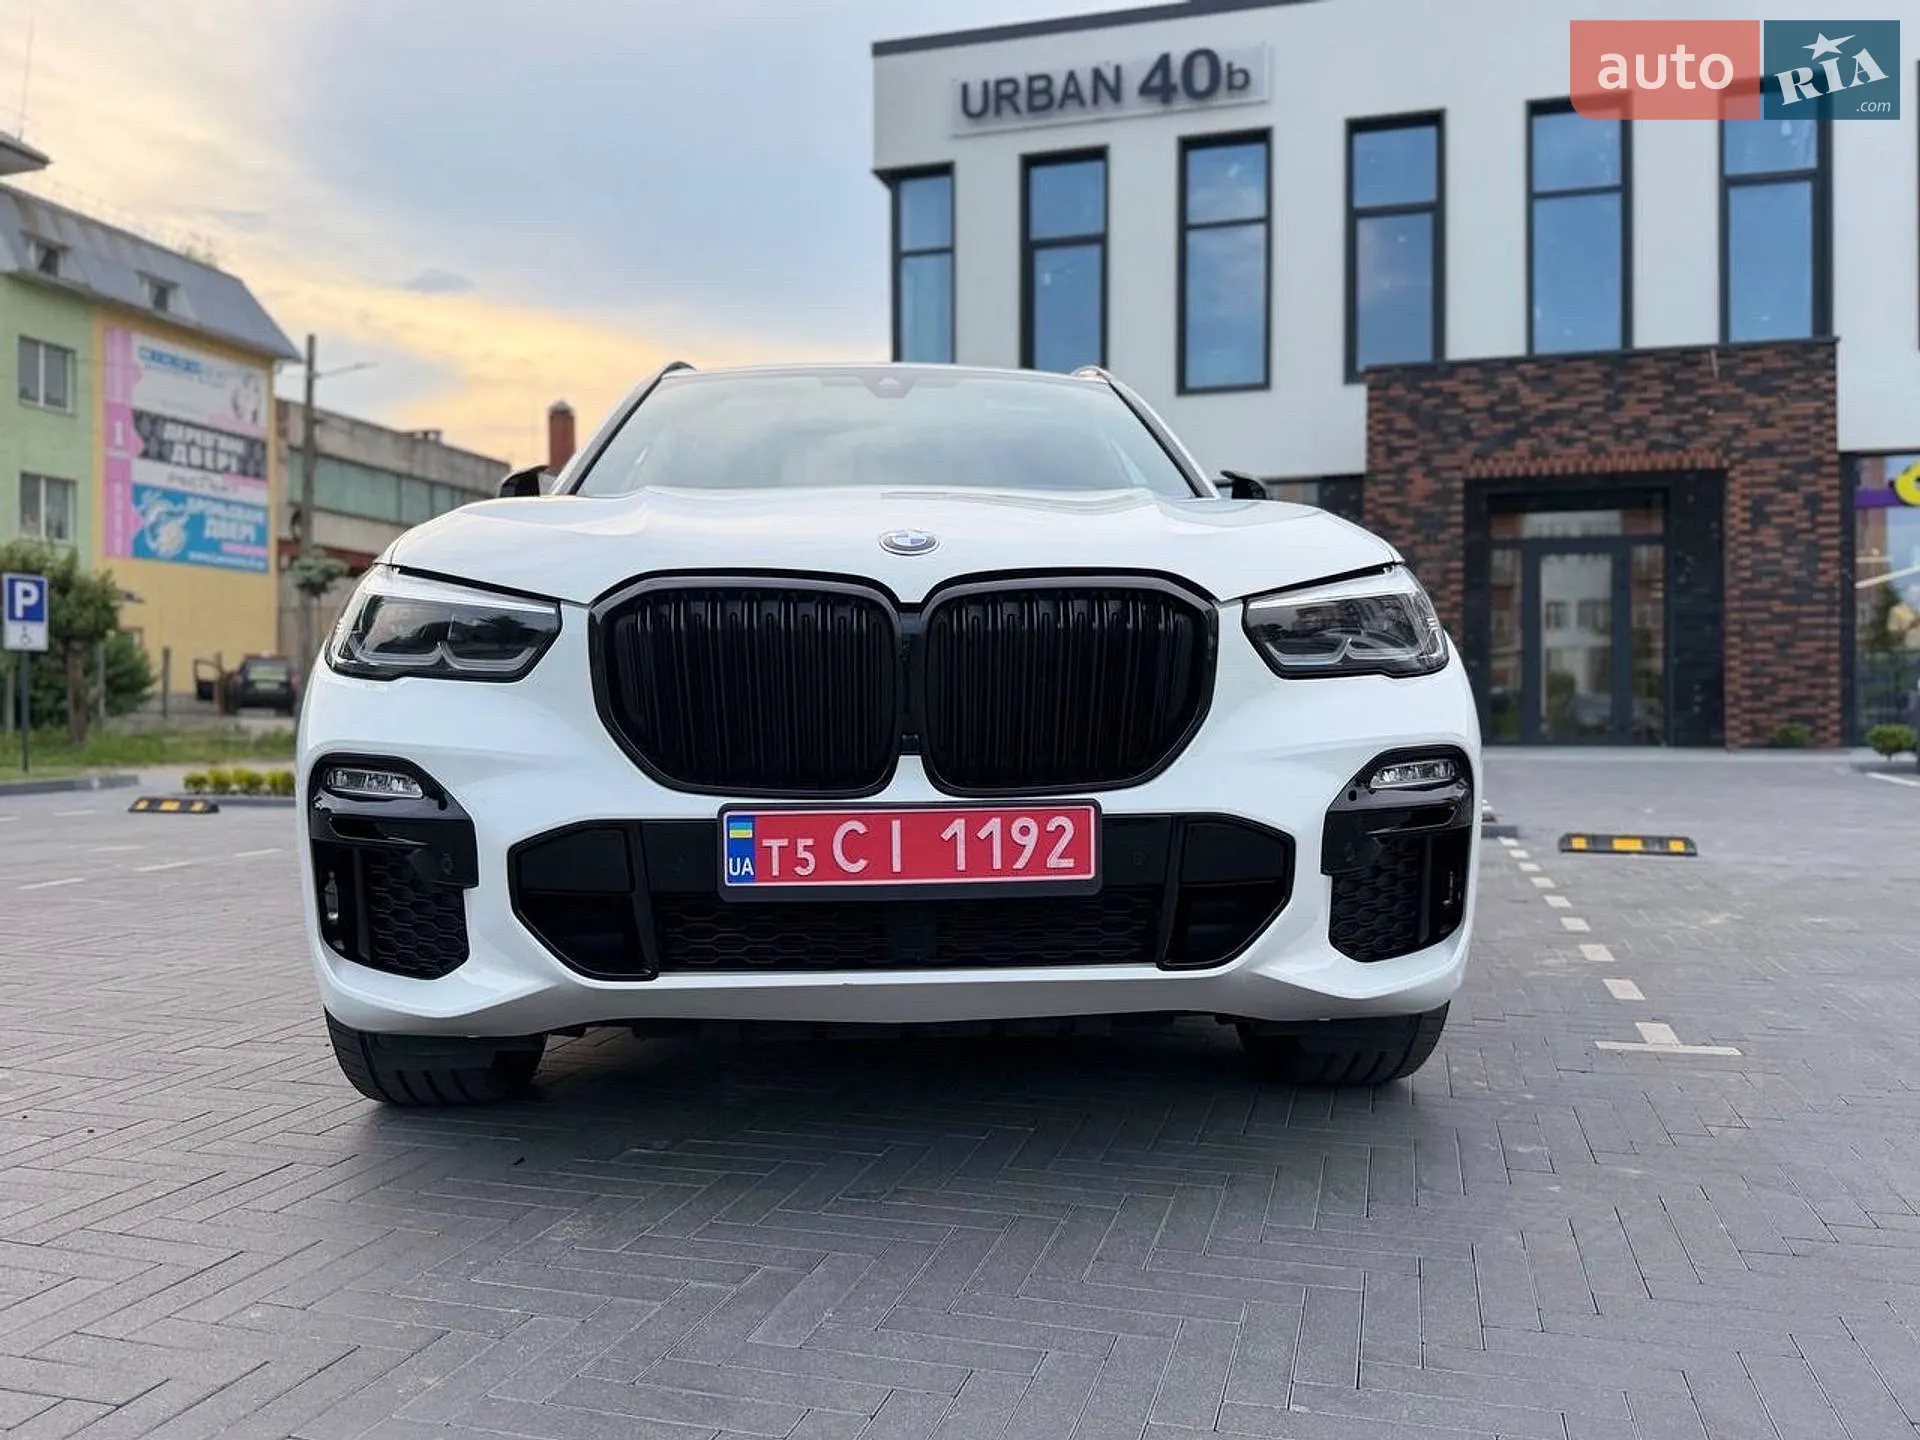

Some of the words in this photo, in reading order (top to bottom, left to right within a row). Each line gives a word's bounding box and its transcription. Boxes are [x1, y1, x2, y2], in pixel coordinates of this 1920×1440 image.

[961, 64, 1122, 119] URBAN
[1138, 47, 1251, 104] 40b
[14, 580, 40, 619] P
[729, 857, 755, 876] UA
[940, 816, 1076, 872] 1192
